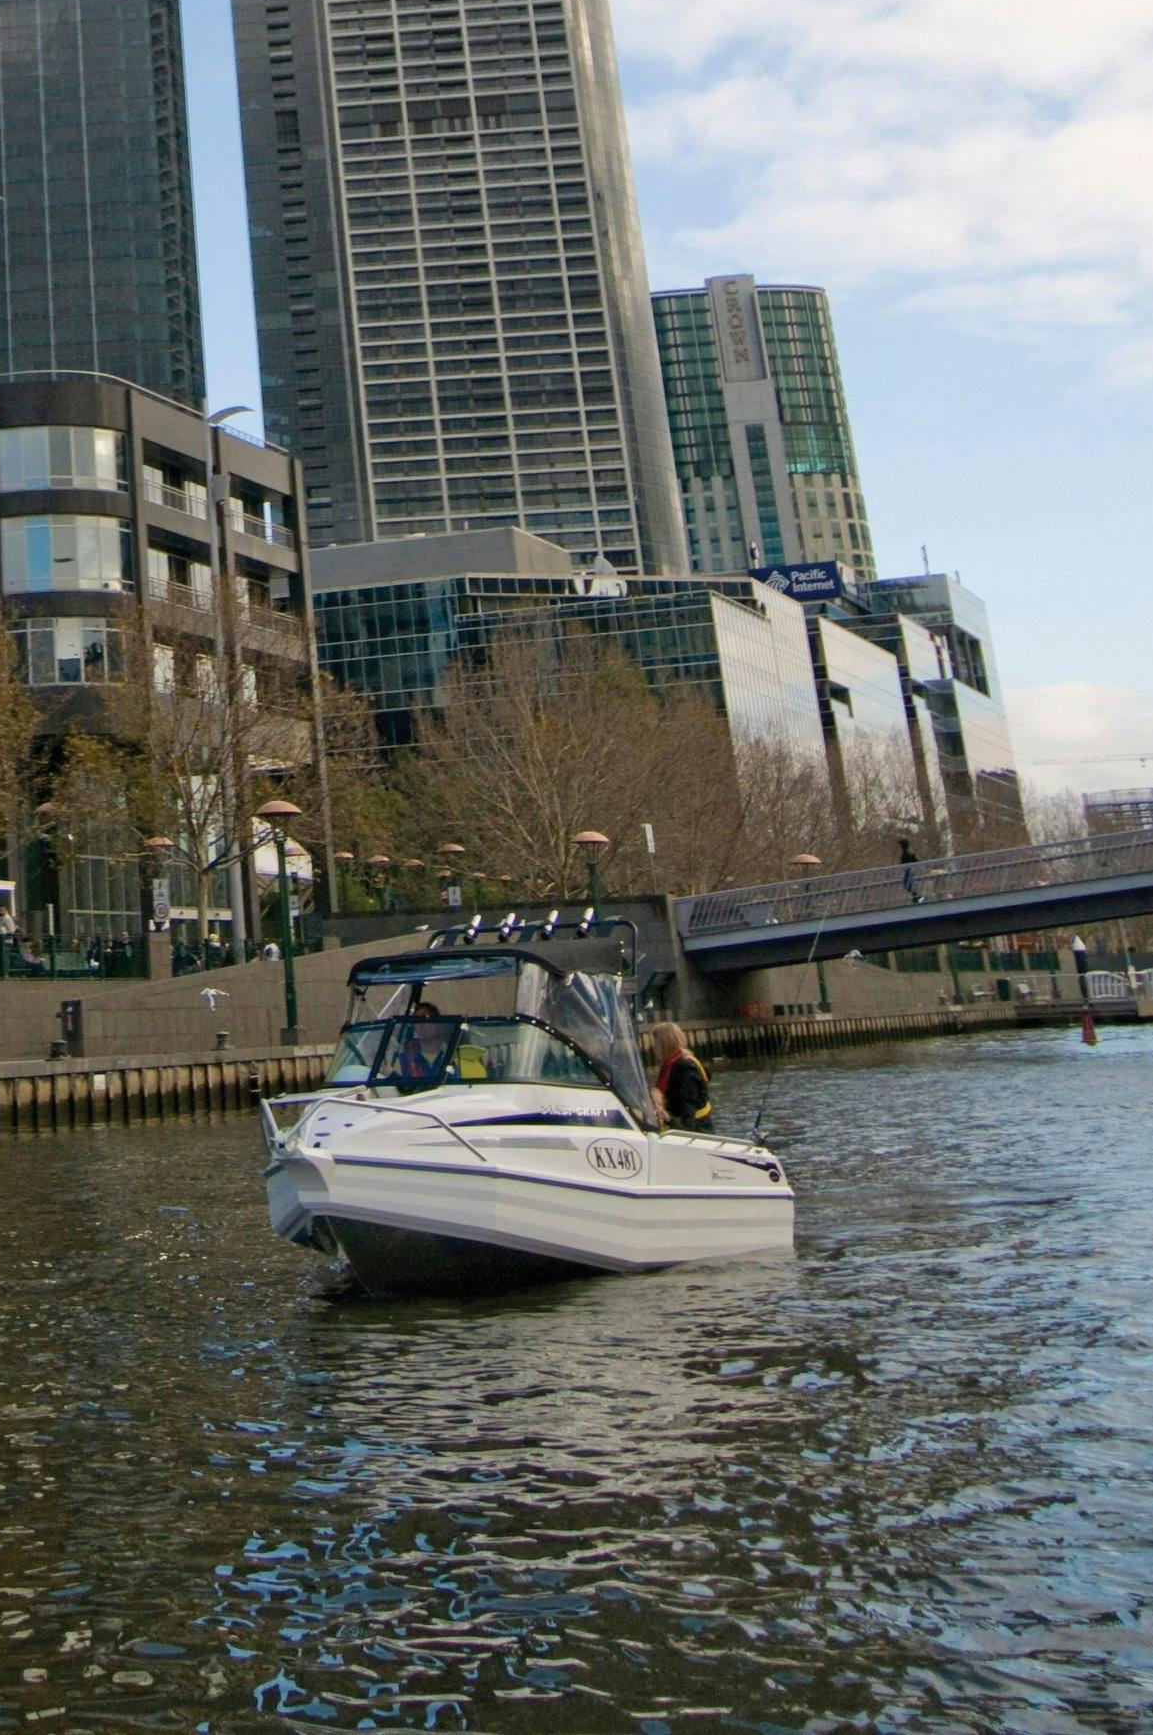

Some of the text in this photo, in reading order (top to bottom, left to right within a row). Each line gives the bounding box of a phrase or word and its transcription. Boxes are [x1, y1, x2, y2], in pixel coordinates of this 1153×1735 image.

[722, 279, 750, 364] CROWN
[790, 568, 827, 582] Pacific
[792, 579, 835, 593] Internet
[593, 1145, 638, 1171] KX481
